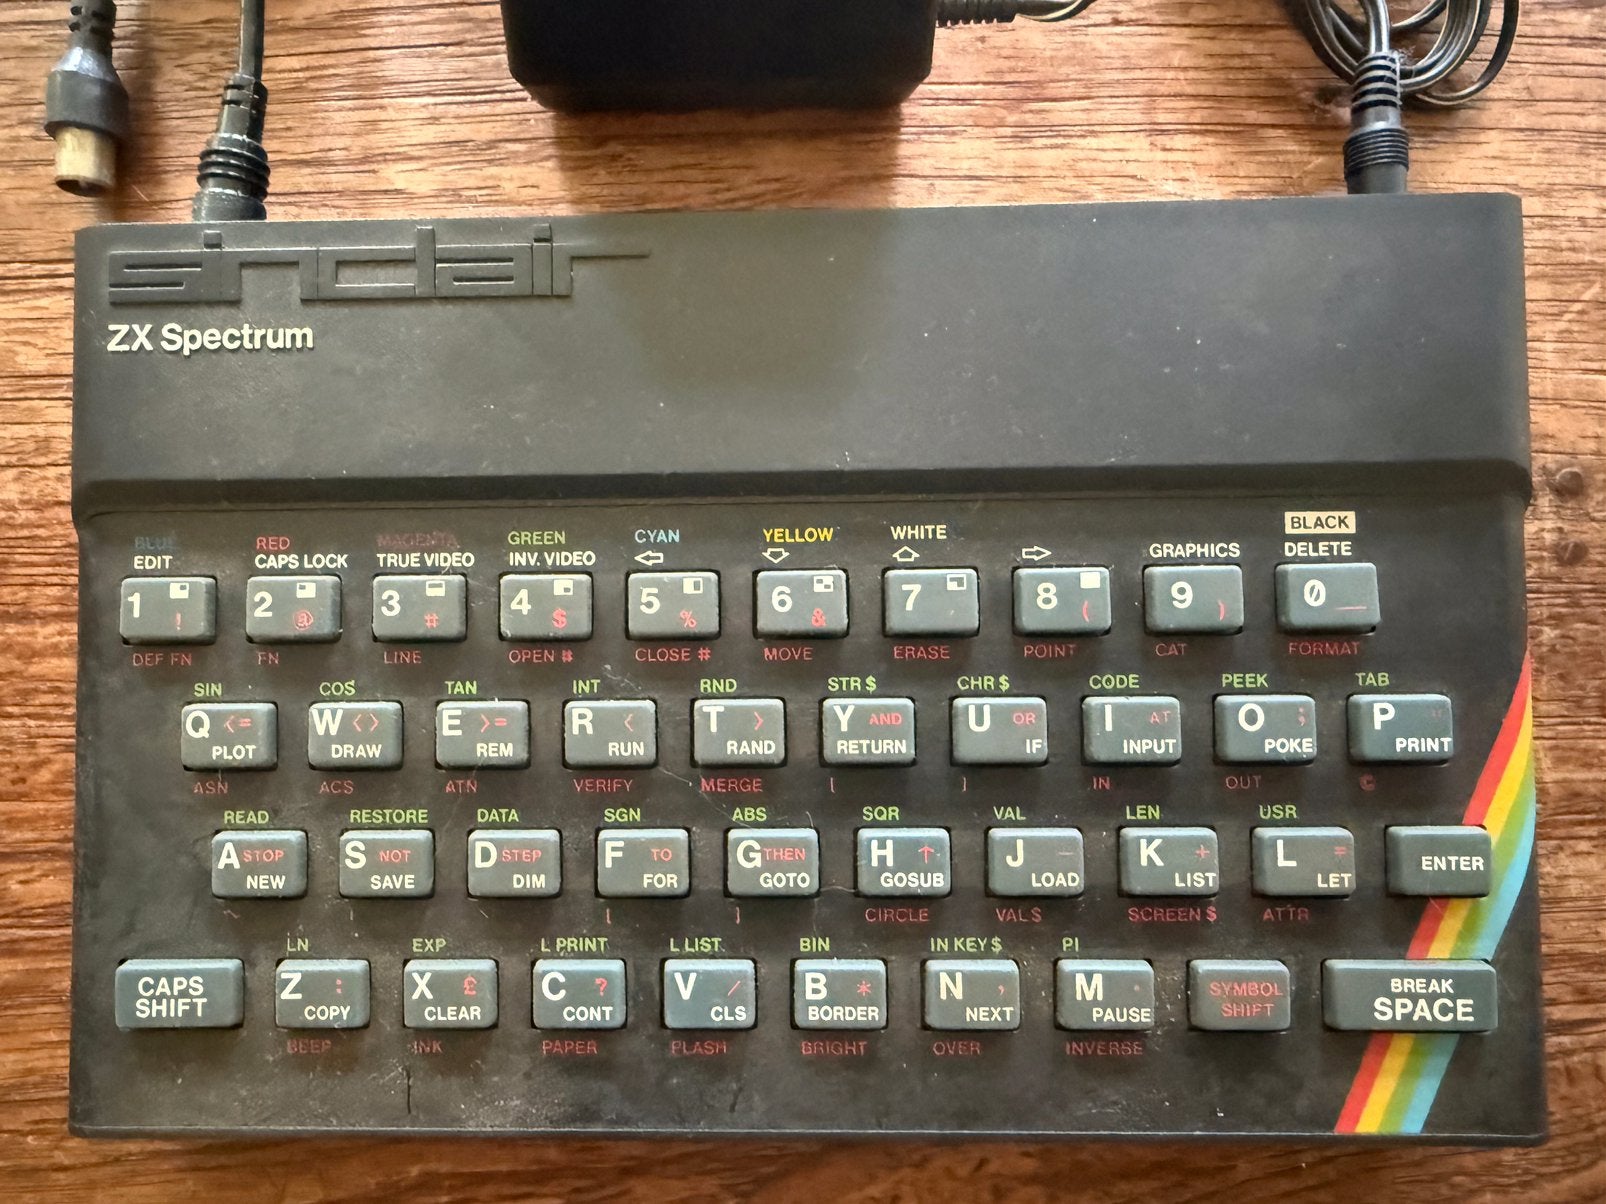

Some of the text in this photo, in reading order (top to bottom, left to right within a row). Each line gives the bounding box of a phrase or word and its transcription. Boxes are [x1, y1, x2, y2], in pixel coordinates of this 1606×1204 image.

[107, 323, 314, 355] ZX Spectrum
[1291, 515, 1349, 530] BLACK
[508, 531, 566, 545] GREEN
[635, 529, 679, 543] CYAN
[763, 528, 833, 542] YELLOW
[891, 526, 947, 539] WHITE
[256, 537, 290, 549] RED
[1284, 542, 1352, 556] DELETE
[1150, 543, 1240, 558] GRAPHICS
[133, 556, 172, 569] EDIT
[255, 554, 348, 569] CAPS LOCK
[377, 553, 474, 568] TRUE VIDEO
[509, 551, 596, 566] INV. VIDEO
[511, 589, 531, 614] 4
[640, 588, 660, 613] 5
[771, 586, 792, 612] 6
[901, 584, 921, 611] 7
[1036, 583, 1057, 609] 8
[1171, 582, 1193, 608] 9
[128, 592, 140, 618] 1
[254, 592, 272, 617] 2
[381, 591, 400, 616] 3
[635, 649, 711, 661] CLOSE #
[764, 648, 812, 661] MOVE
[894, 646, 950, 659] ERASE
[1024, 644, 1075, 657] POINT
[1155, 643, 1188, 656] CAT
[1289, 642, 1360, 655] FORMAT
[133, 653, 191, 666] DEF FN
[258, 652, 279, 664] FN
[384, 652, 421, 664] LINE
[509, 650, 573, 662] OPEN #
[573, 680, 600, 693] INT
[701, 679, 736, 692] RND
[828, 676, 877, 692] STR $
[957, 674, 1010, 692] CHR $
[1089, 675, 1139, 688] CODE
[1222, 674, 1269, 688] PEEK
[1356, 673, 1389, 687] TAB
[194, 683, 222, 696] SIN
[320, 681, 355, 696] COS
[445, 681, 477, 695] TAN
[312, 710, 343, 735] W
[442, 710, 462, 735] E
[572, 708, 593, 734] R
[702, 707, 724, 732] T
[833, 705, 854, 731] Y
[869, 713, 902, 725] AND
[968, 705, 990, 732] U
[1013, 712, 1035, 724] OR
[1104, 705, 1112, 731] I
[1150, 711, 1171, 723] AT
[1238, 703, 1264, 731] O
[1373, 703, 1395, 730] P
[186, 710, 210, 738] Q
[331, 744, 382, 758] DRAW
[476, 743, 513, 757] REM
[608, 742, 644, 756] RUN
[727, 741, 775, 755] RAND
[837, 740, 906, 753] RETURN
[1026, 739, 1042, 753] IF
[1123, 739, 1176, 753] INPUT
[1264, 738, 1313, 753] POKE
[1396, 738, 1452, 752] PRINT
[212, 745, 256, 760] PLOT
[194, 782, 228, 794] ASN
[320, 781, 354, 793] ACS
[446, 780, 477, 793] ATN
[574, 779, 632, 792] VERIFY
[701, 779, 762, 792] MERGE
[1092, 777, 1109, 790] IN
[1226, 776, 1261, 789] OUT
[224, 811, 269, 824] READ
[351, 809, 428, 823] RESTORE
[477, 809, 519, 822] DATA
[604, 808, 641, 822] SGN
[732, 808, 767, 821] ABS
[863, 807, 899, 821] SQR
[993, 807, 1026, 820] VAL
[1127, 806, 1160, 820] LEN
[1260, 805, 1297, 819] USR
[218, 842, 240, 869] A
[243, 850, 284, 862] STOP
[345, 841, 366, 869] S
[379, 850, 410, 862] NOT
[474, 841, 497, 868] D
[502, 849, 541, 862] STEP
[605, 841, 624, 868] F
[652, 848, 672, 861] TO
[736, 840, 761, 868] G
[763, 848, 805, 860] THEN
[871, 839, 893, 867] H
[1006, 839, 1023, 867] J
[1140, 839, 1164, 866] K
[1277, 839, 1297, 867] L
[1422, 856, 1484, 871] ENTER
[247, 875, 285, 889] NEW
[371, 875, 415, 890] SAVE
[513, 874, 546, 888] DIM
[643, 873, 678, 888] FOR
[760, 873, 810, 888] GOTO
[881, 872, 944, 888] GOSUB
[1032, 872, 1080, 887] LOAD
[1175, 872, 1216, 887] LIST
[1318, 873, 1351, 888] LET
[866, 908, 929, 921] CIRCLE
[1128, 906, 1217, 922] SCREEN $
[1263, 908, 1309, 920] ATTR
[287, 938, 308, 951] LN
[413, 939, 446, 952] EXP
[541, 938, 607, 952] L PRINT
[670, 938, 722, 952] L LIST
[800, 938, 829, 951] BIN
[1063, 938, 1079, 951] PI
[138, 977, 203, 996] CAPS
[281, 972, 302, 999] Z
[412, 972, 433, 999] X
[541, 972, 566, 1000] C
[674, 973, 696, 1000] V
[805, 973, 827, 1000] B
[939, 972, 962, 999] N
[1076, 973, 1103, 1000] M
[1209, 982, 1283, 996] SYMBOL
[1391, 978, 1453, 993] BREAK
[136, 998, 207, 1018] SHIFT
[304, 1006, 350, 1020] COPY
[425, 1006, 481, 1020] CLEAR
[563, 1006, 613, 1021] CONT
[710, 1006, 746, 1021] CLS
[808, 1007, 879, 1021] BORDER
[966, 1007, 1013, 1022] NEXT
[1092, 1007, 1151, 1022] PAUSE
[1222, 1003, 1274, 1017] SHIFT
[1374, 999, 1474, 1022] SPACE
[543, 1041, 597, 1054] PAPER
[933, 1042, 980, 1055] OVER
